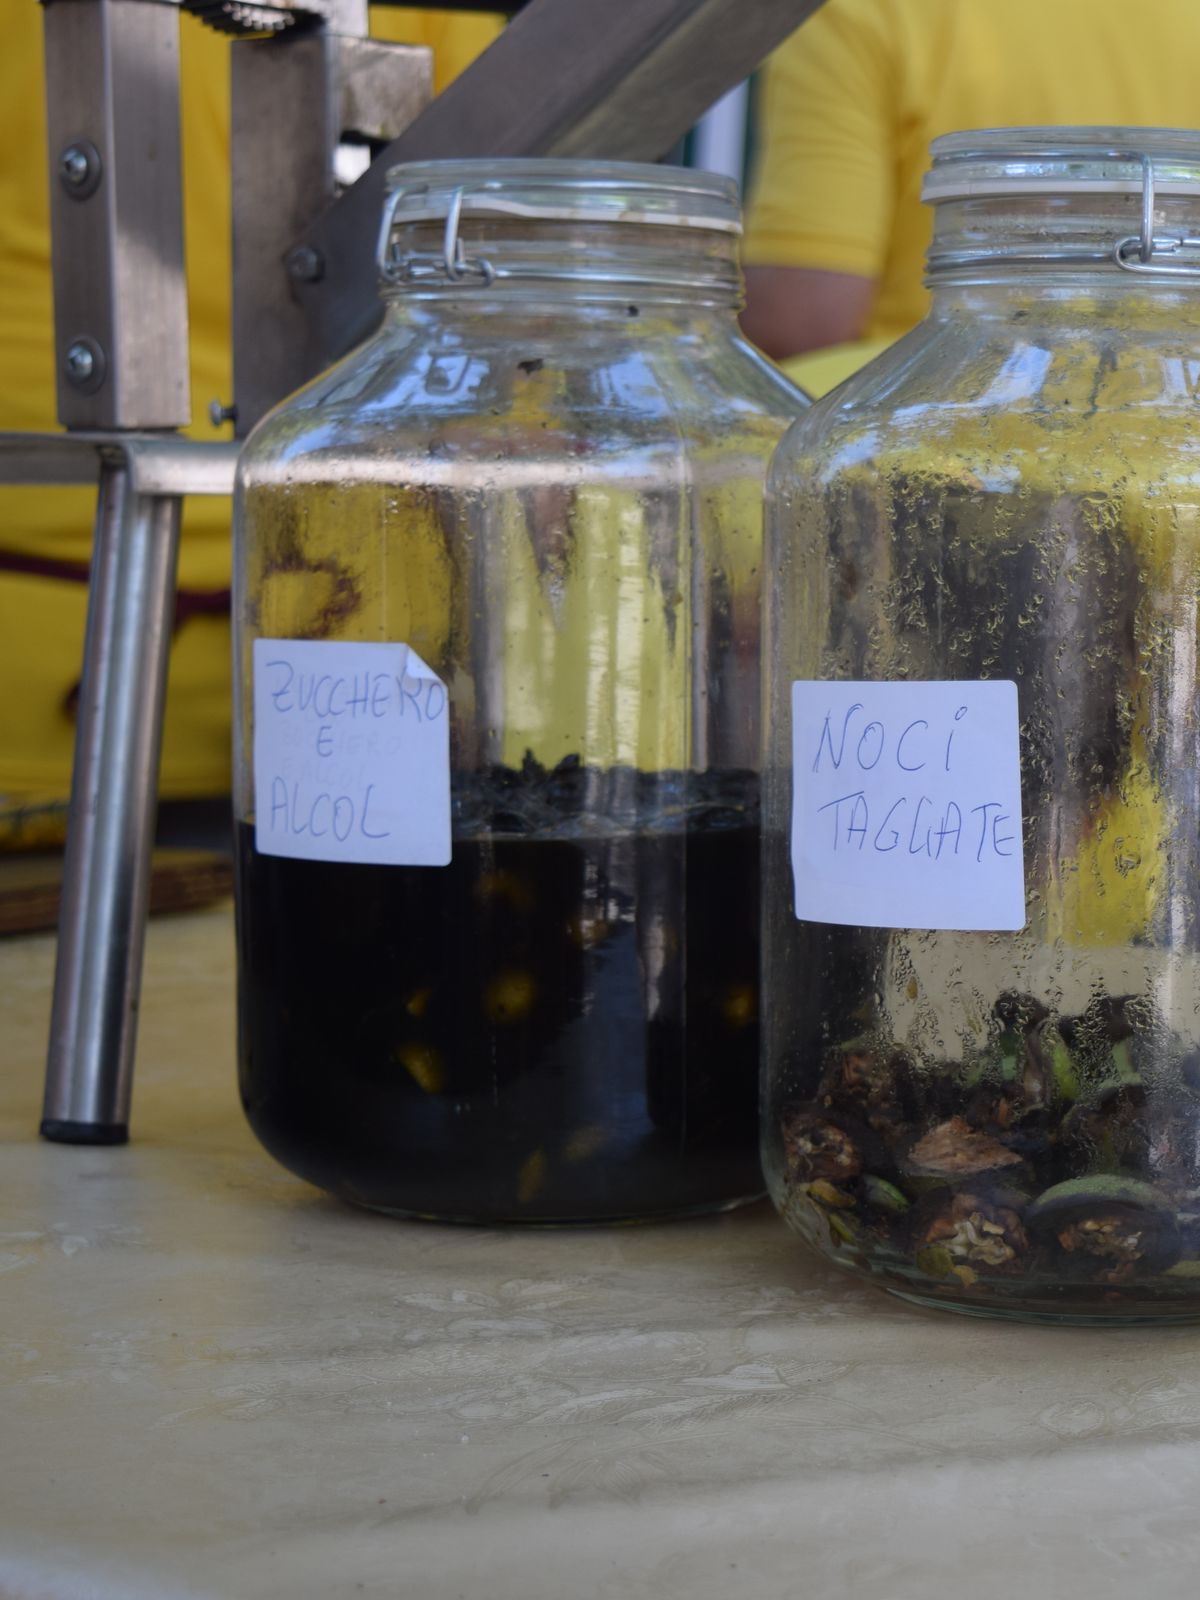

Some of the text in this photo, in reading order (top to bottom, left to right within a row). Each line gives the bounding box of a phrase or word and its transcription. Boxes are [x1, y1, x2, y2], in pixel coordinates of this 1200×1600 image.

[265, 660, 446, 723] ZUCCHERO
[316, 725, 334, 758] E
[270, 775, 391, 842] ALCOL
